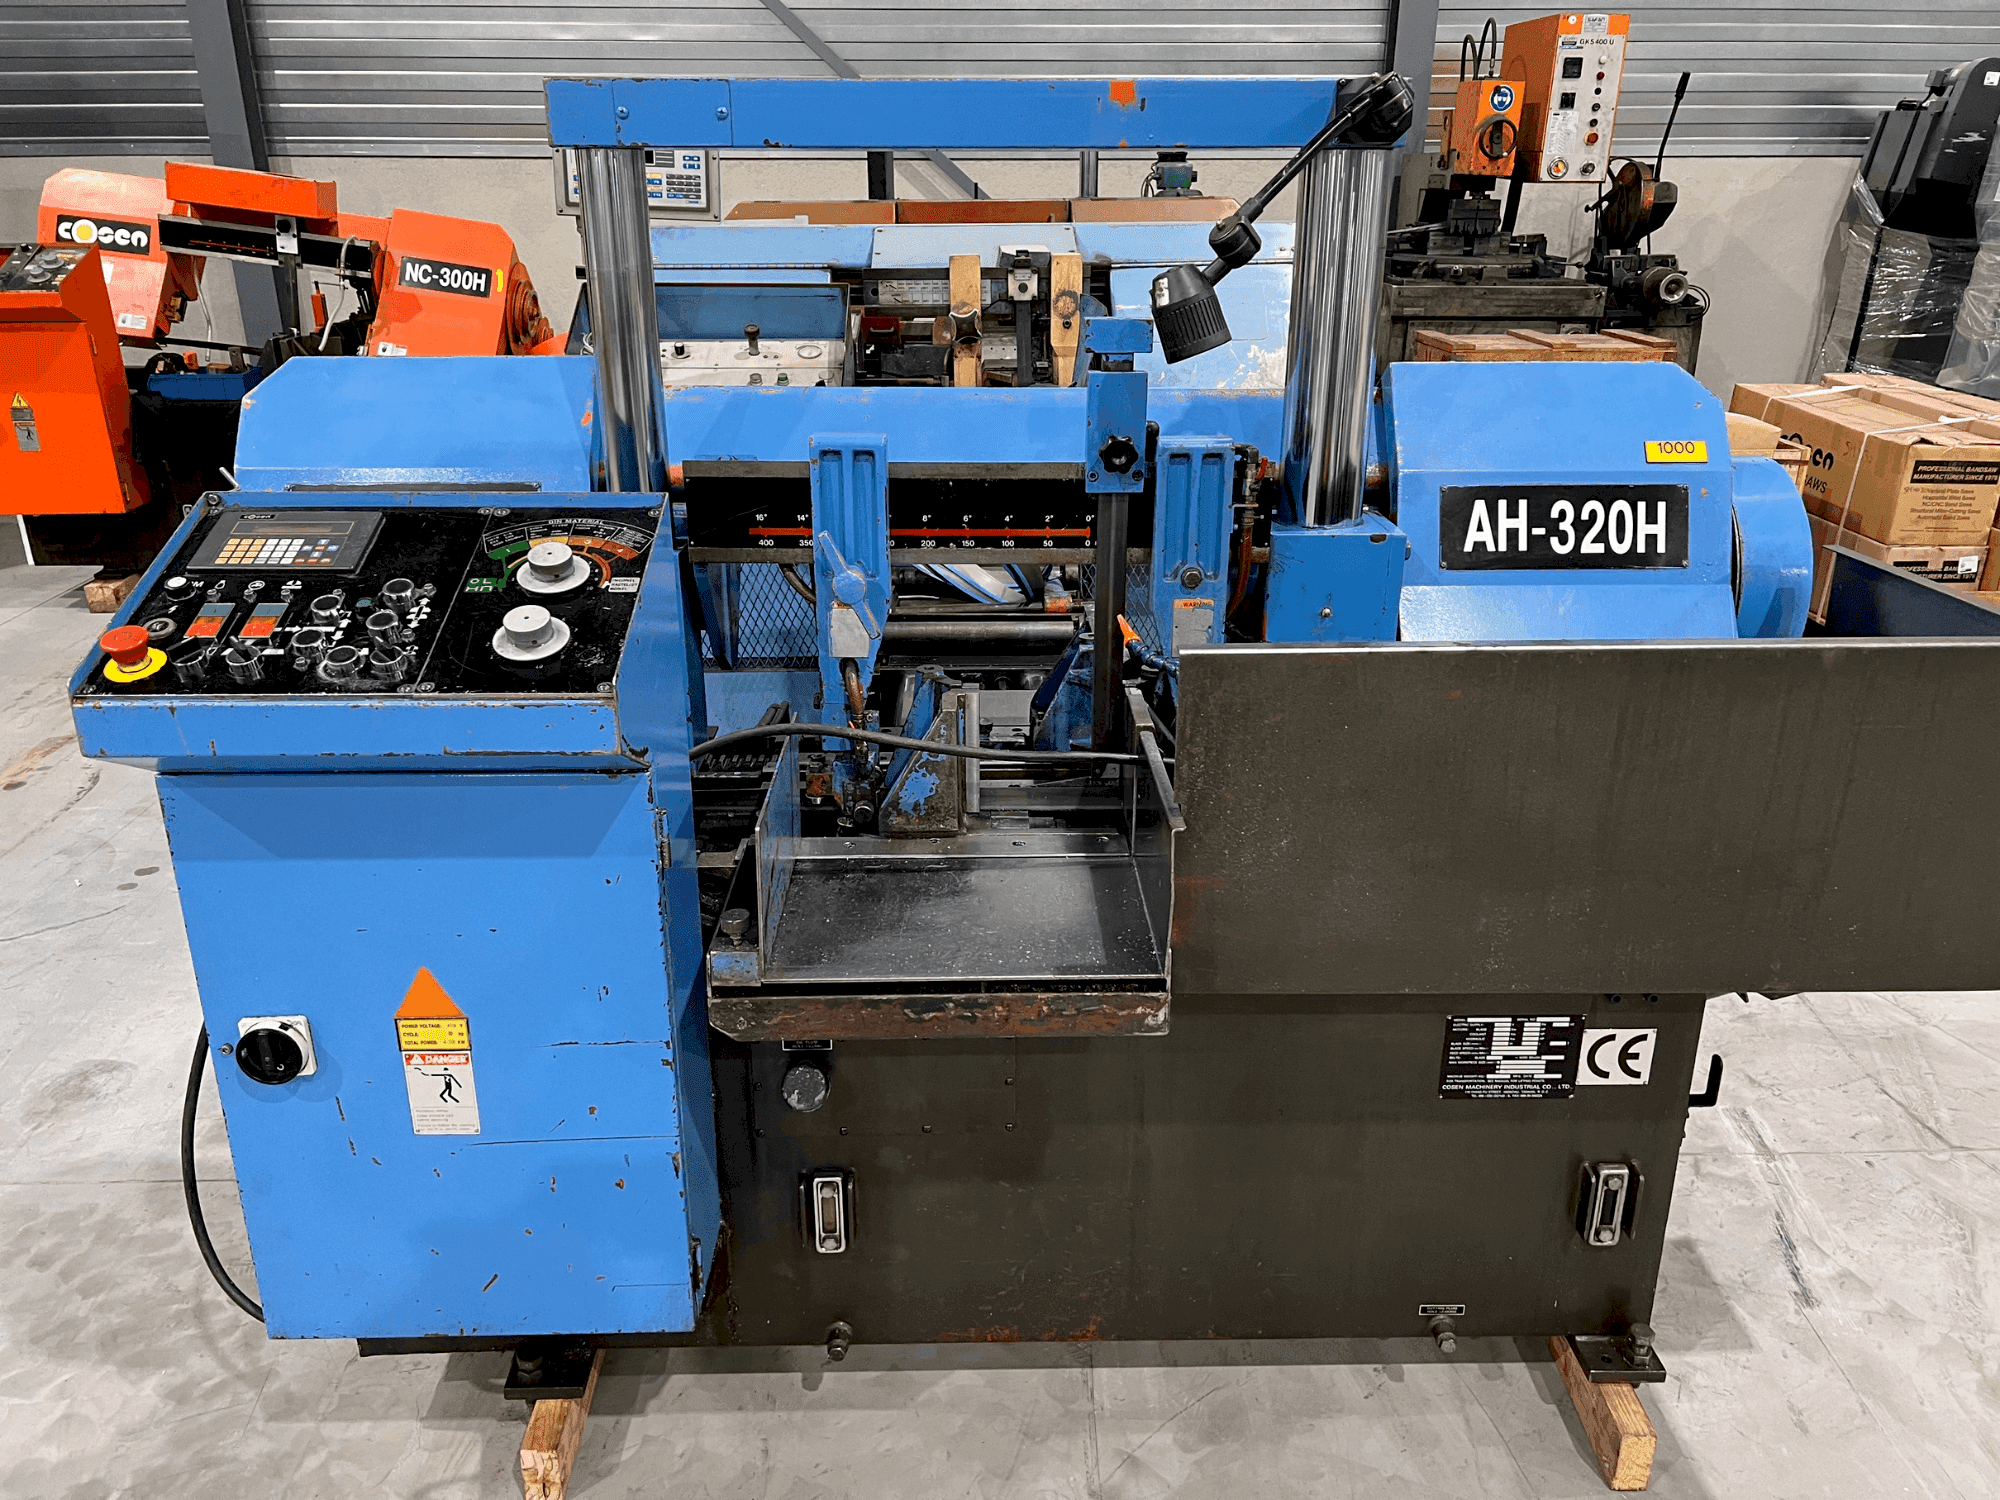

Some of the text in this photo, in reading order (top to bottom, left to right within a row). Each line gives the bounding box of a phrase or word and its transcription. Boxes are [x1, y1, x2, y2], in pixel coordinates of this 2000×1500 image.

[405, 262, 486, 292] NC-300H
[1657, 441, 1695, 454] 1000
[1917, 465, 1965, 473] PROFESSIONAL
[1462, 498, 1667, 556] AH-320H
[758, 539, 774, 547] 400
[799, 539, 814, 547] 350
[921, 540, 936, 548] 200
[425, 1055, 467, 1064] DANGER
[1586, 1033, 1649, 1079] CE
